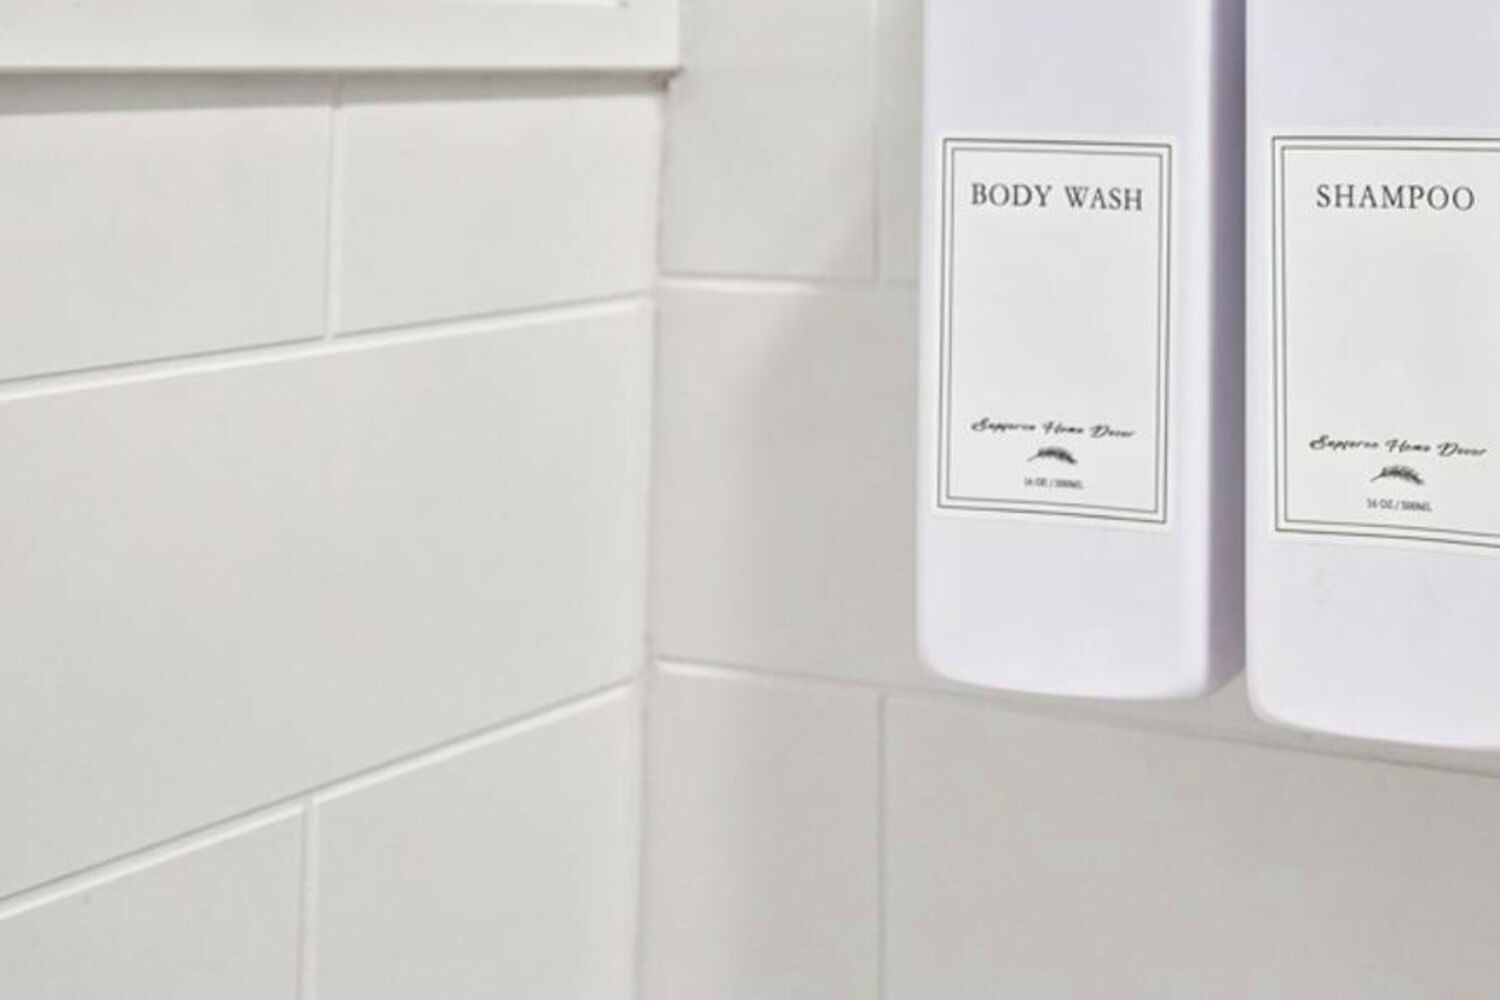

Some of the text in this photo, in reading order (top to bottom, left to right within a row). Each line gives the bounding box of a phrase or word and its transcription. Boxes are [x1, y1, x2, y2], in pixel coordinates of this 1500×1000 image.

[970, 181, 1143, 212] BODY WASH
[1315, 183, 1476, 212] SHAMPOO
[1042, 420, 1084, 436] Home
[1385, 437, 1431, 454] Home
